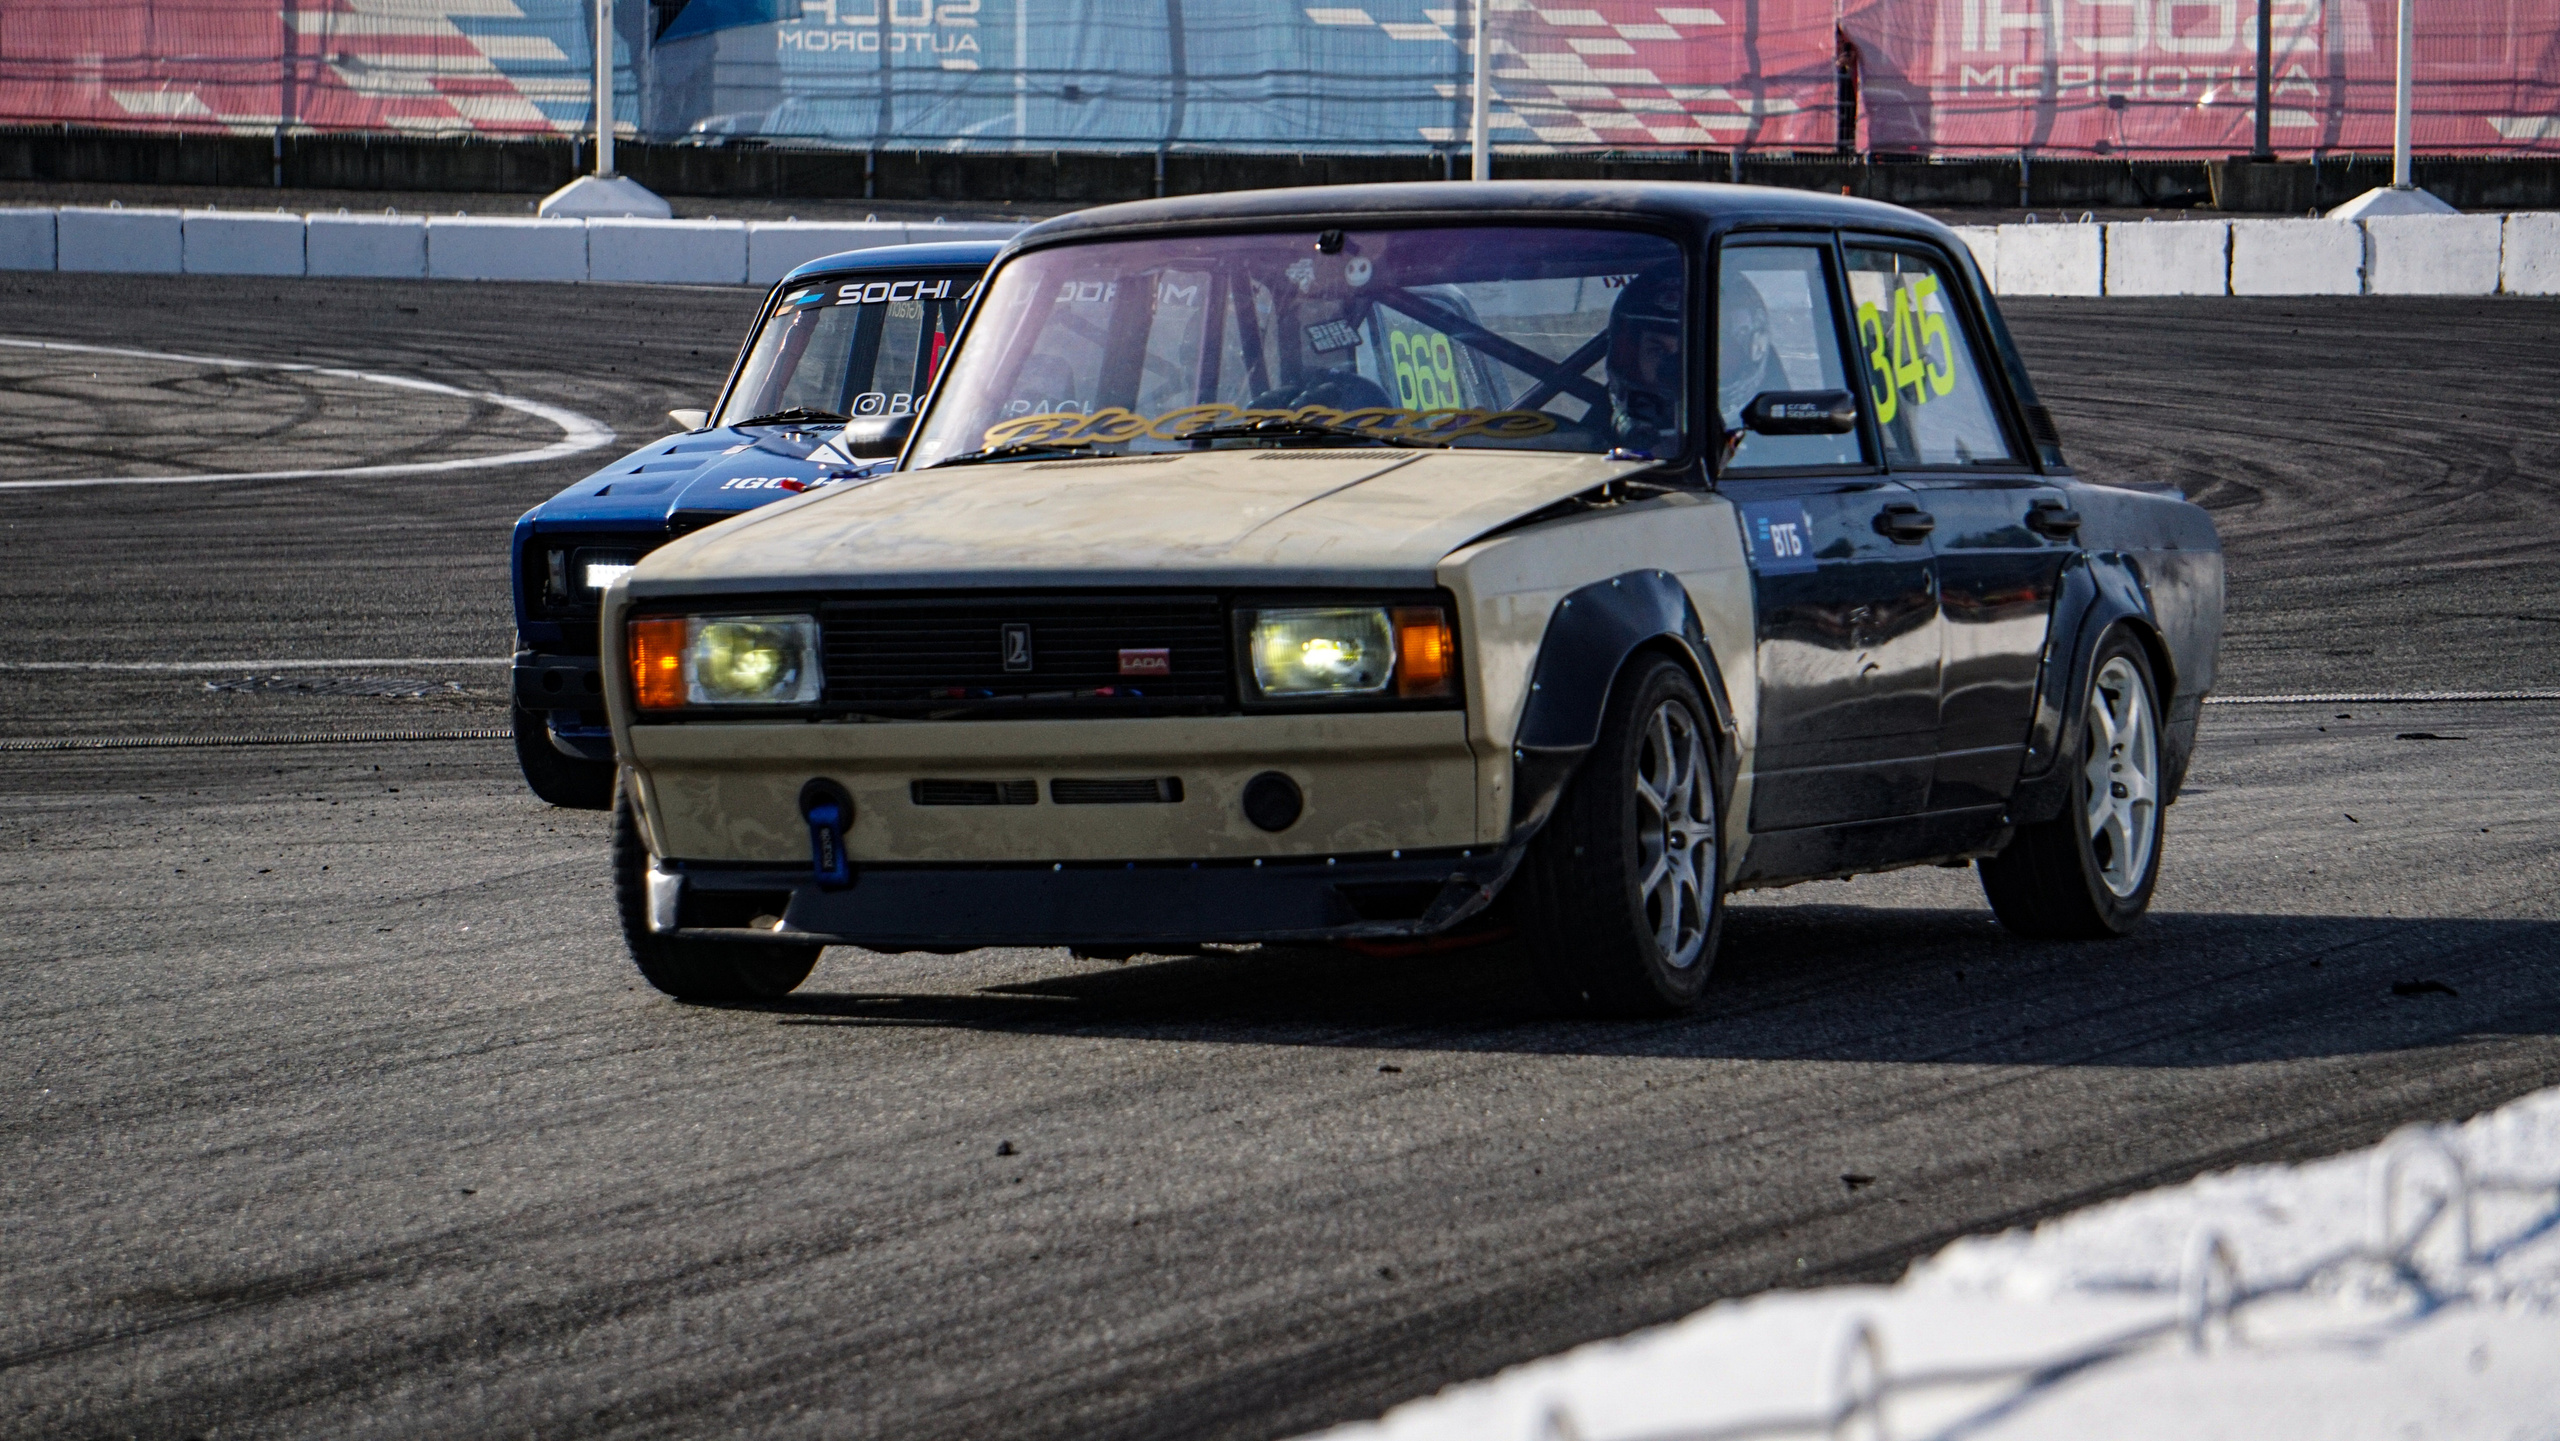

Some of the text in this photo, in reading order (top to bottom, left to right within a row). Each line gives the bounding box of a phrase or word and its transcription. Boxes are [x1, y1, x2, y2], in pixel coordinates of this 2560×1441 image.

[834, 279, 952, 306] SOCHI
[1857, 274, 1956, 424] 345
[1390, 330, 1461, 410] 669
[1769, 522, 1802, 557] ВТБ
[1121, 657, 1167, 669] LADA
